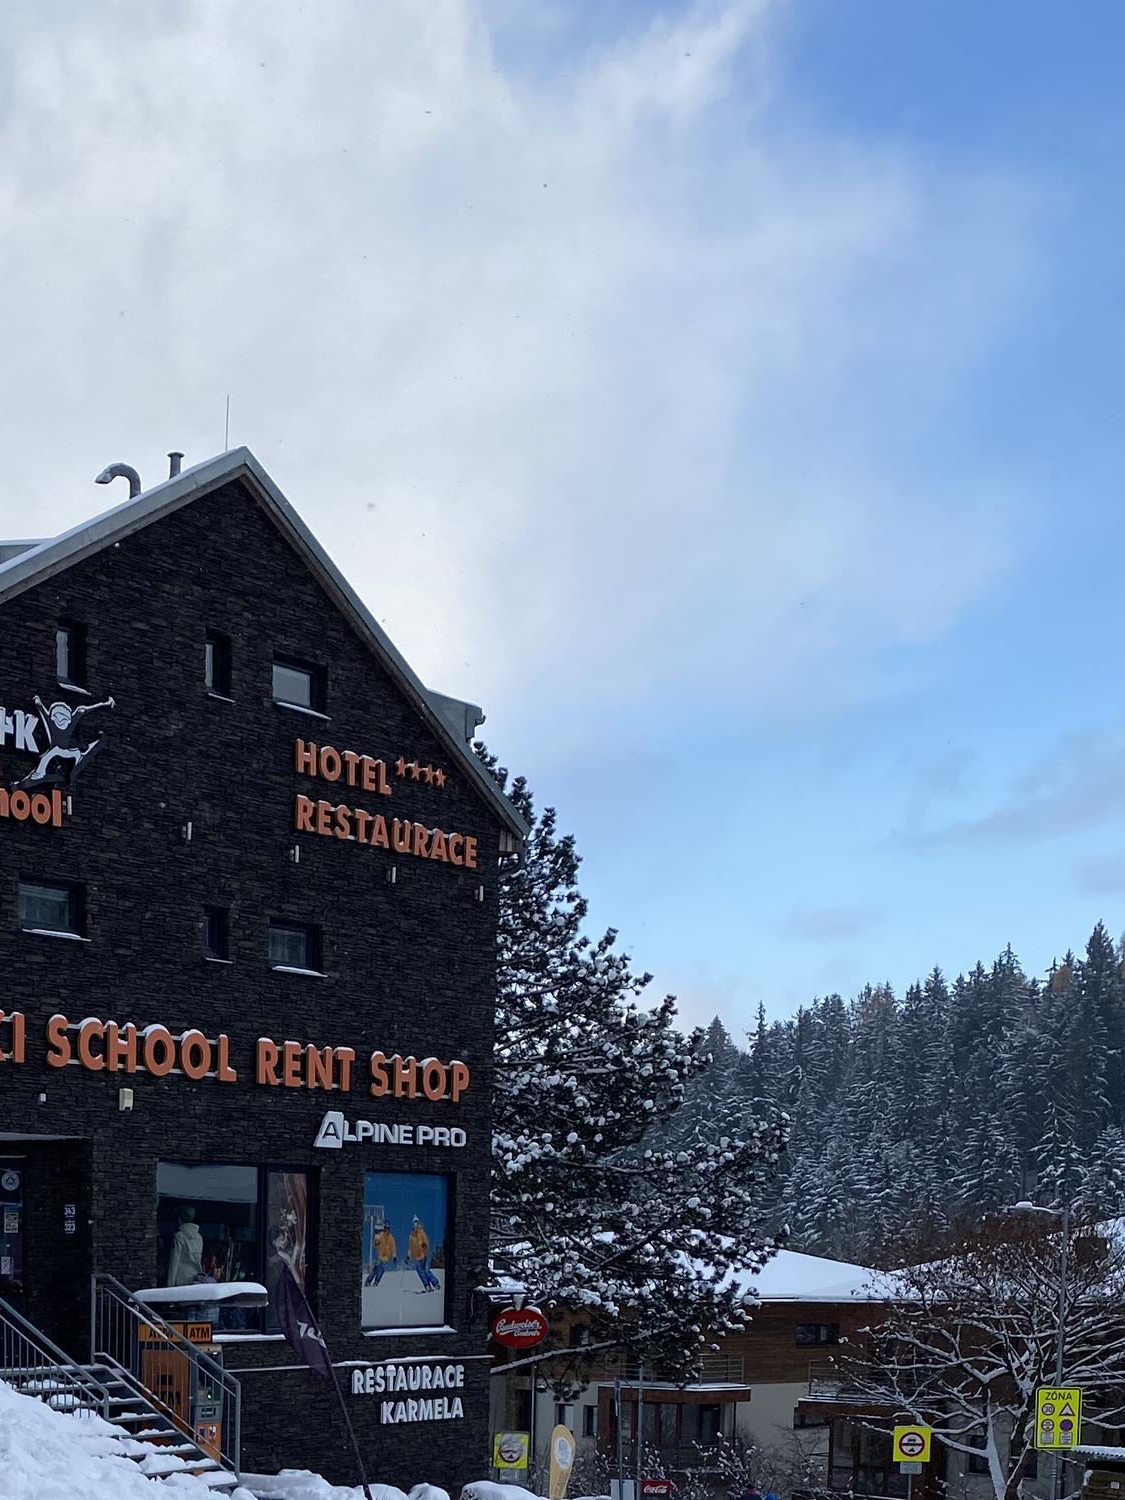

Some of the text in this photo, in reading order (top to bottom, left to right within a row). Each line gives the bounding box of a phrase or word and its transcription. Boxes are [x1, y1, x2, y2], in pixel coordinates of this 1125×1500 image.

[295, 738, 392, 796] HOTEL
[295, 794, 477, 868] RESTAURACE
[46, 1014, 237, 1083] SCHOOL
[257, 1037, 355, 1092] RENT
[370, 1050, 470, 1102] SHOP
[314, 1111, 467, 1148] ALPINE PRO
[189, 1327, 210, 1338] ATM
[351, 1365, 465, 1394] RESTAURACE
[380, 1396, 464, 1424] KARMELA
